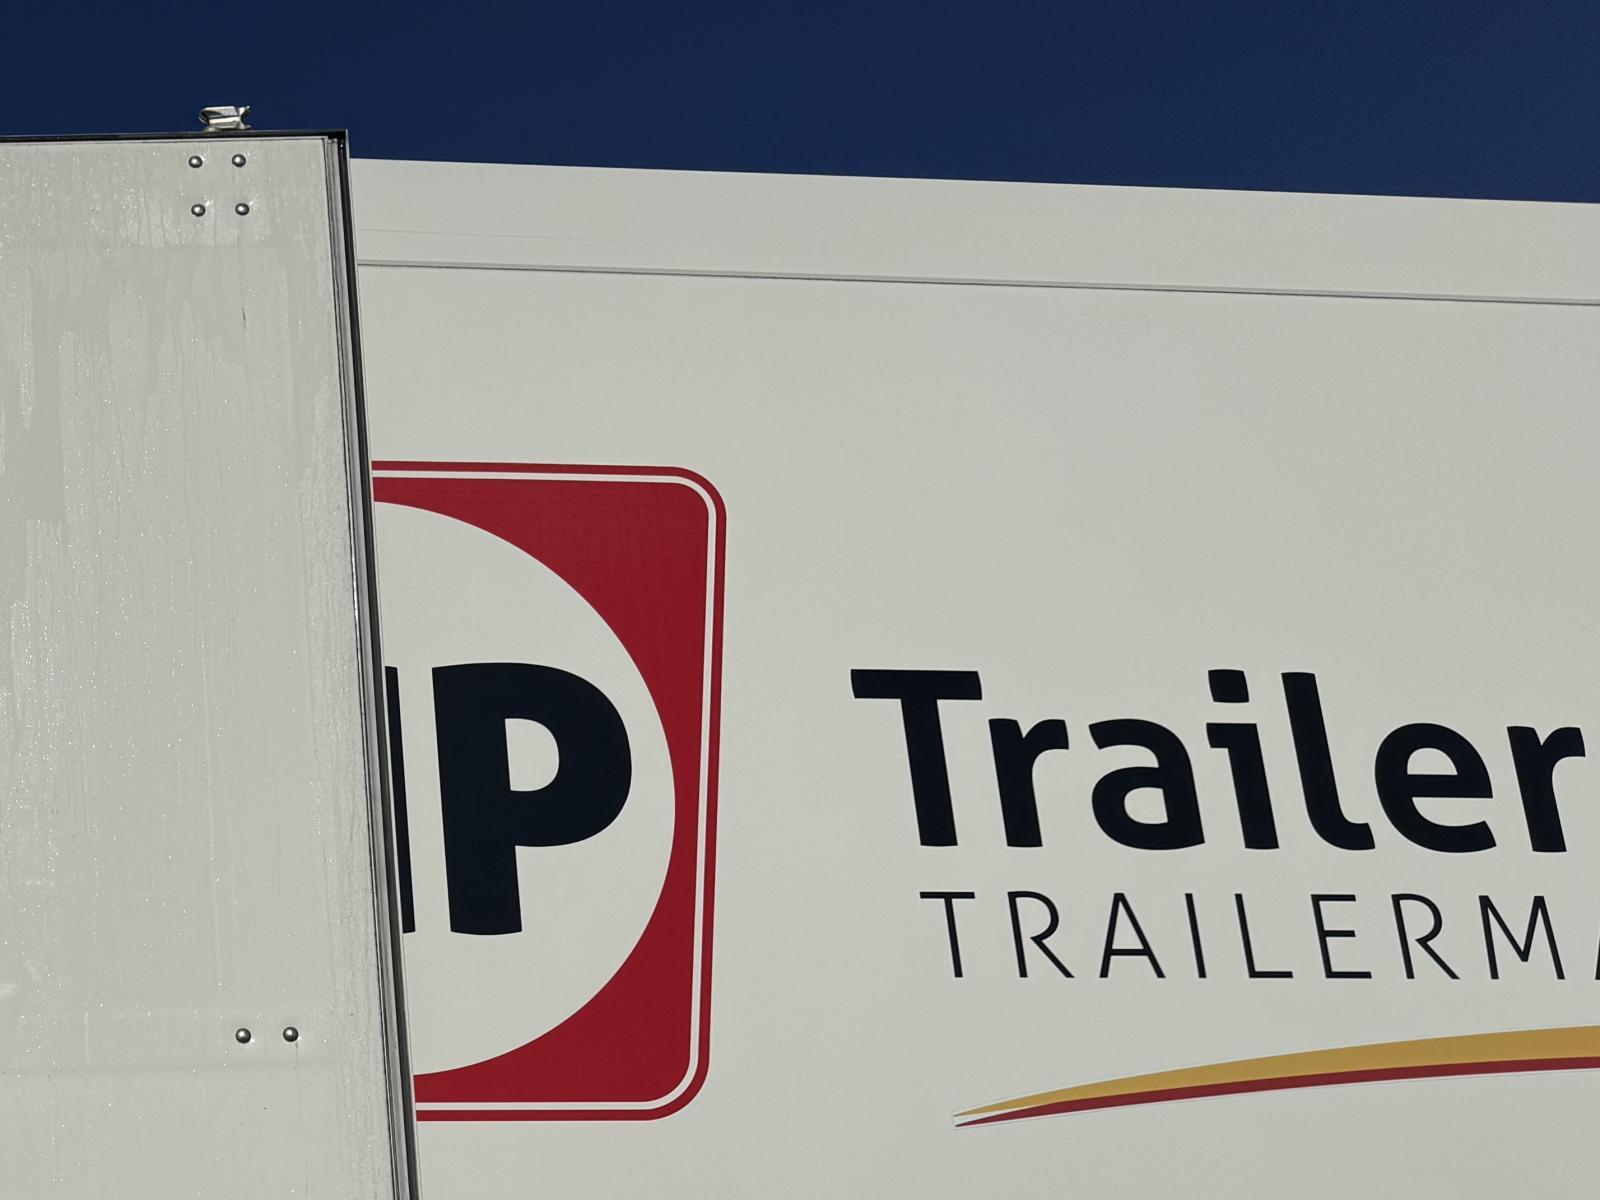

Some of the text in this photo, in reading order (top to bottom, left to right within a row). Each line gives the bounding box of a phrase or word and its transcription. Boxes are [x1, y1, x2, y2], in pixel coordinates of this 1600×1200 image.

[385, 662, 633, 936] P
[851, 669, 1585, 853] Trailer
[920, 890, 1600, 980] TRAILERM
